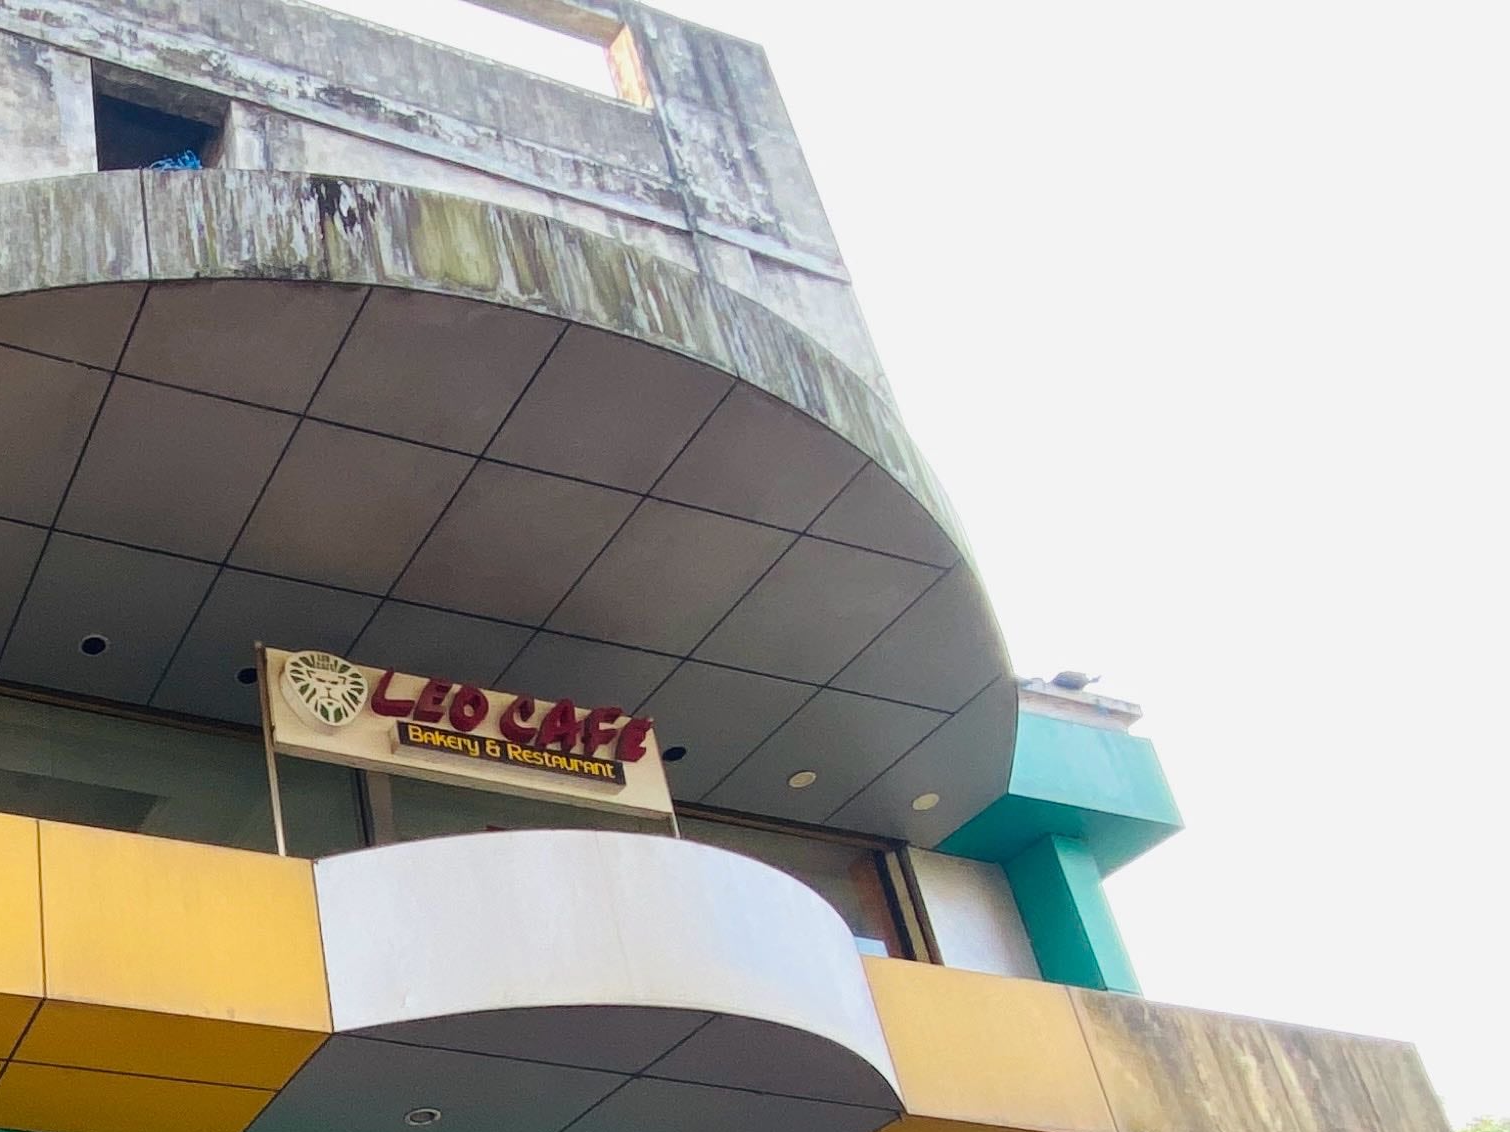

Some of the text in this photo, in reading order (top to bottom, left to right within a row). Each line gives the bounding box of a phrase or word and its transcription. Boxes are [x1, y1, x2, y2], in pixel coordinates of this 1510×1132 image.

[370, 667, 653, 763] LEO CAFE
[408, 725, 616, 779] Bakery & Restaurant
